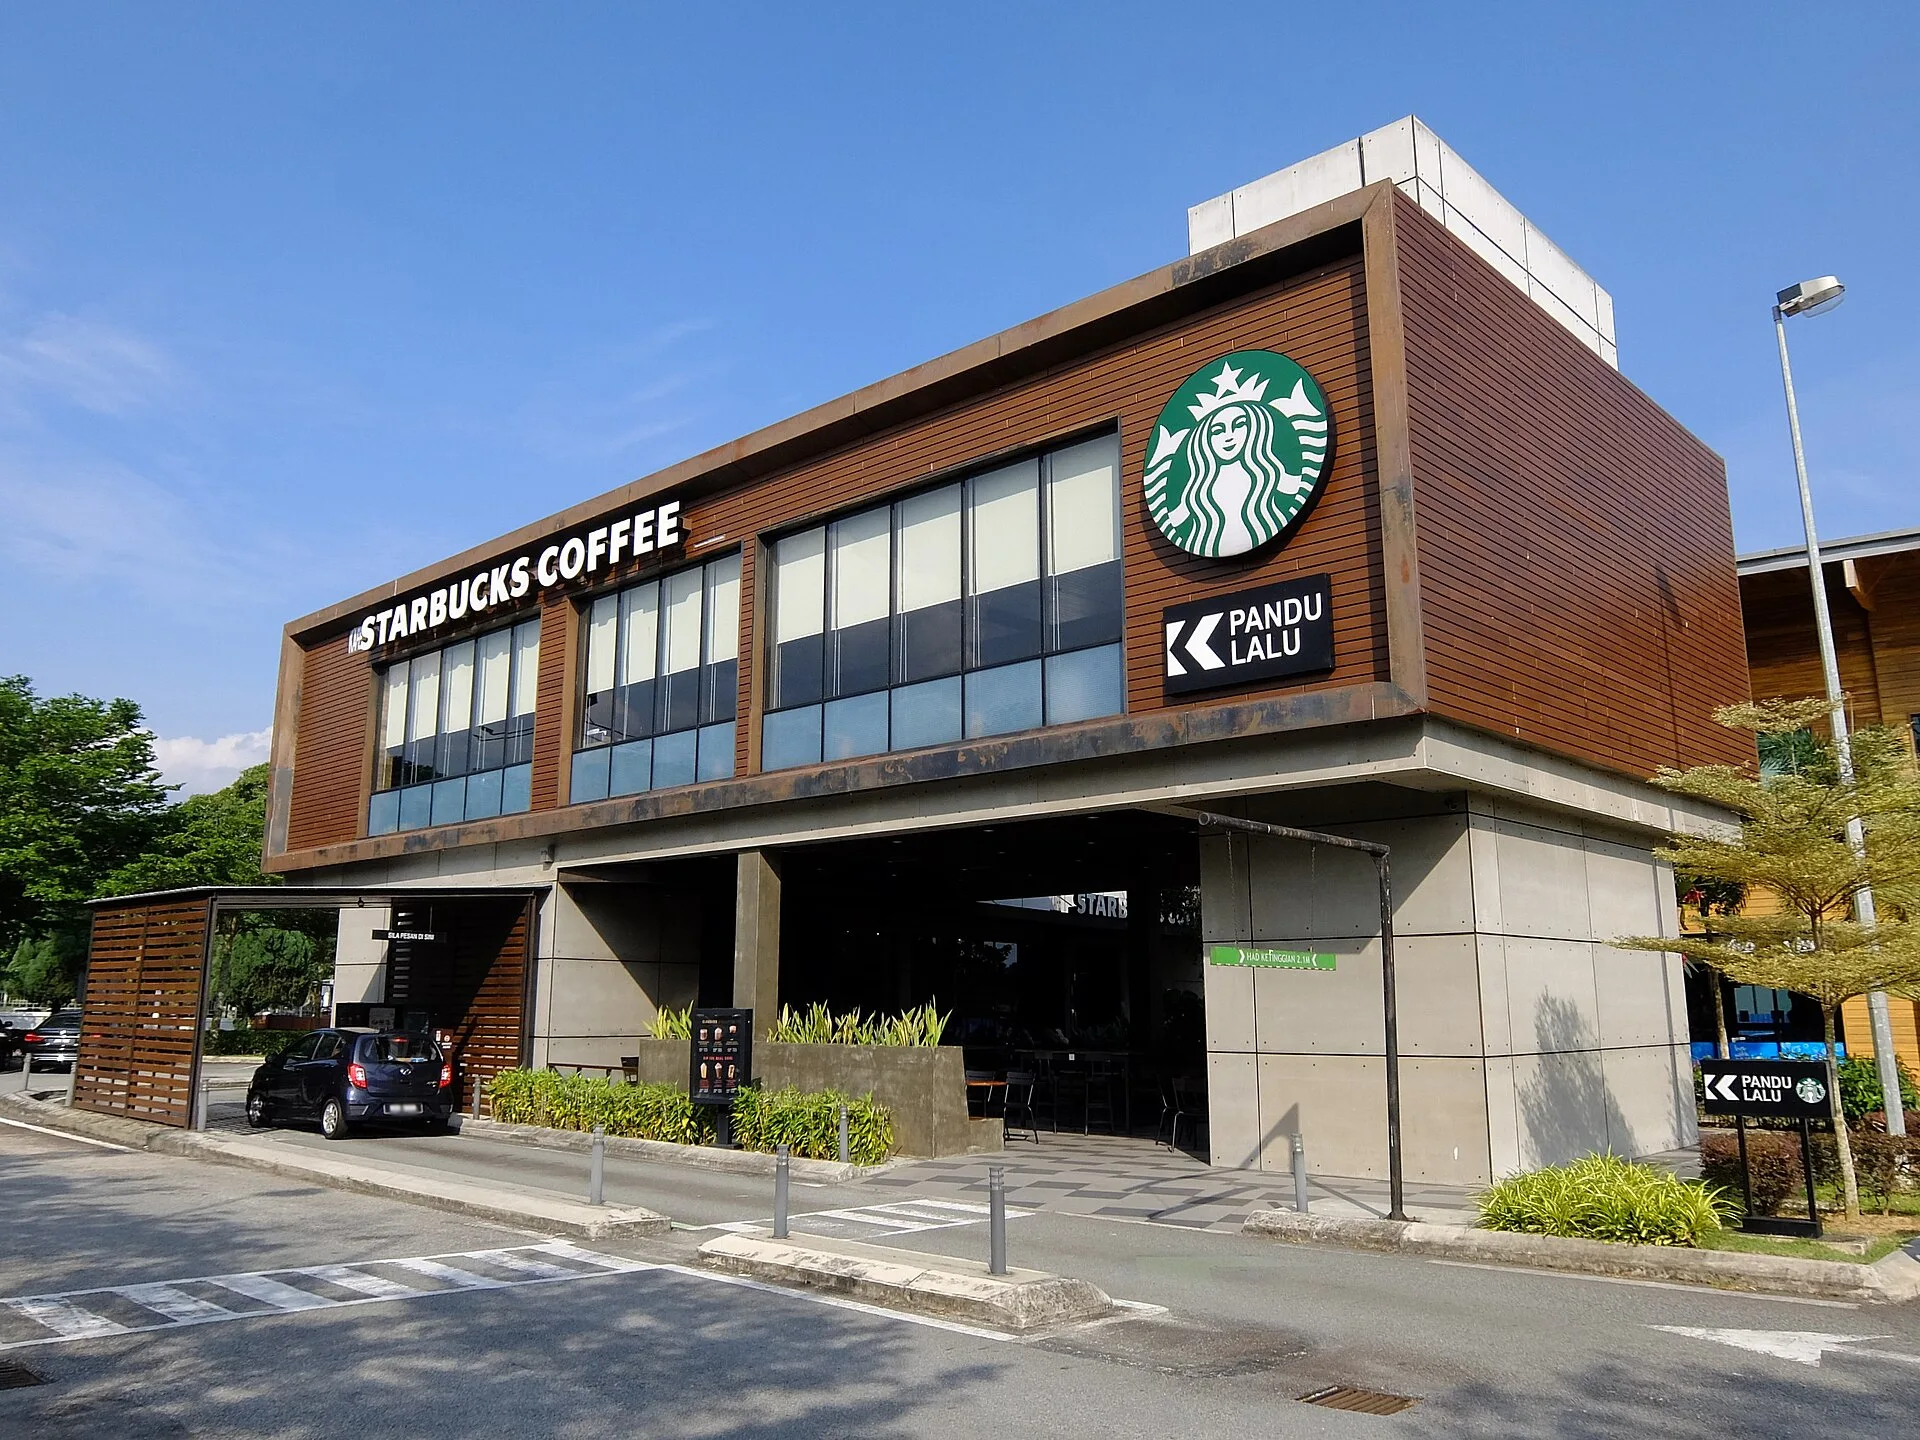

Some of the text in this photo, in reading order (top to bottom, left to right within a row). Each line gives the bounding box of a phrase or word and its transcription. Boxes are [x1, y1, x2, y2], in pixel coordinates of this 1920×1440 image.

[360, 501, 680, 651] STARBUCKS COFFEE
[1229, 592, 1323, 636] PANDU
[1230, 627, 1301, 666] LALU
[1077, 893, 1128, 919] STARB
[1246, 951, 1260, 962] HAD
[1741, 1075, 1792, 1089] PANDU
[1742, 1088, 1782, 1102] LALU
